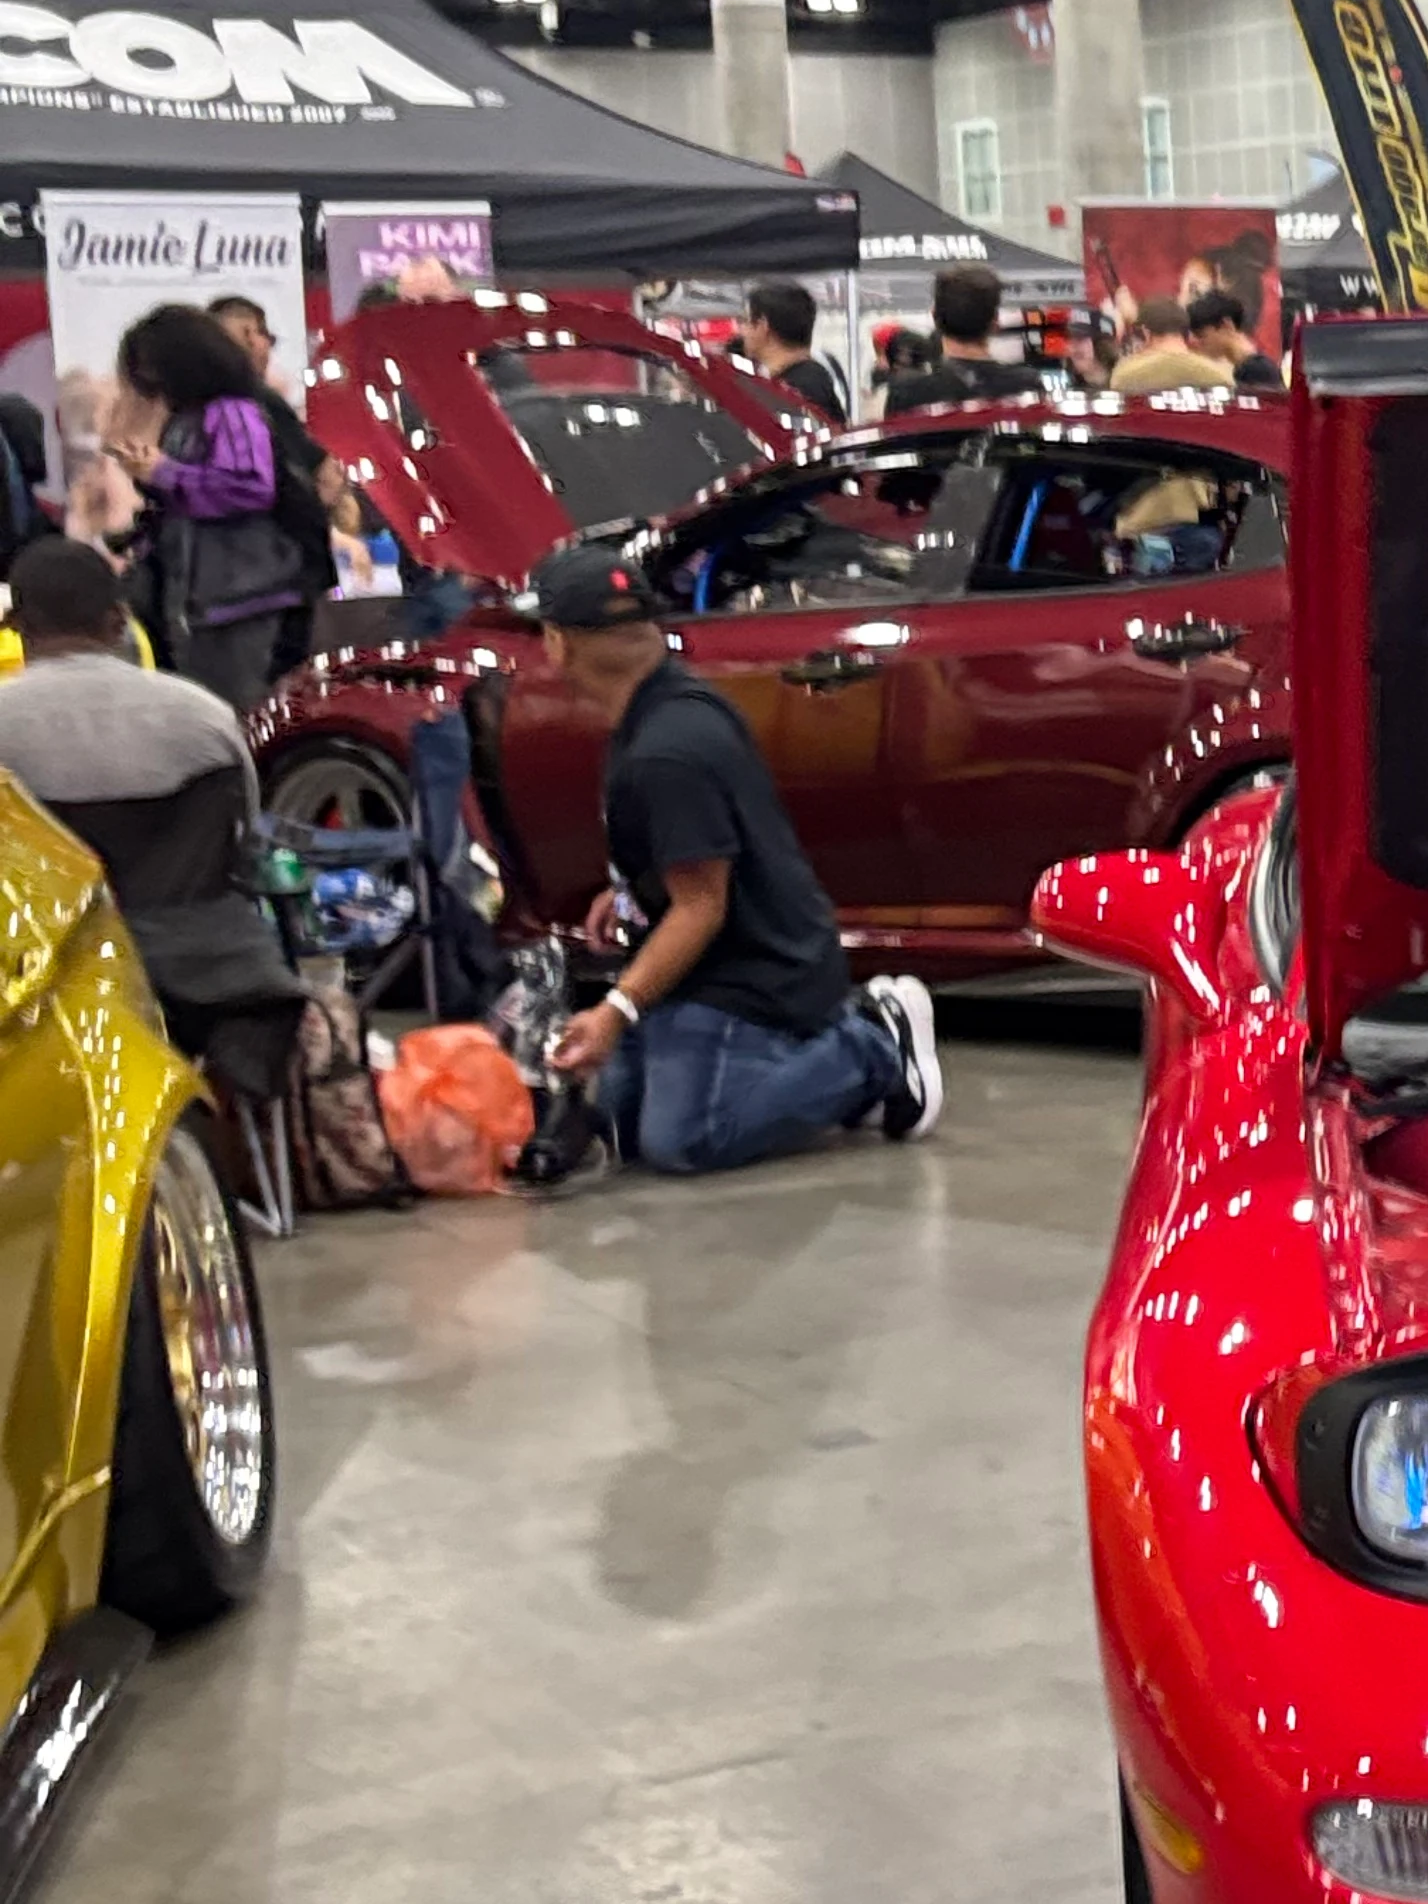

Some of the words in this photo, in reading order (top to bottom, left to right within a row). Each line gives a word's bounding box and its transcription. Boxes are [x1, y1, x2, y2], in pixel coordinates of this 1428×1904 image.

[57, 214, 187, 272] Jamie
[192, 218, 293, 277] Luna
[379, 221, 481, 250] KIMI
[358, 249, 485, 278] PAK
